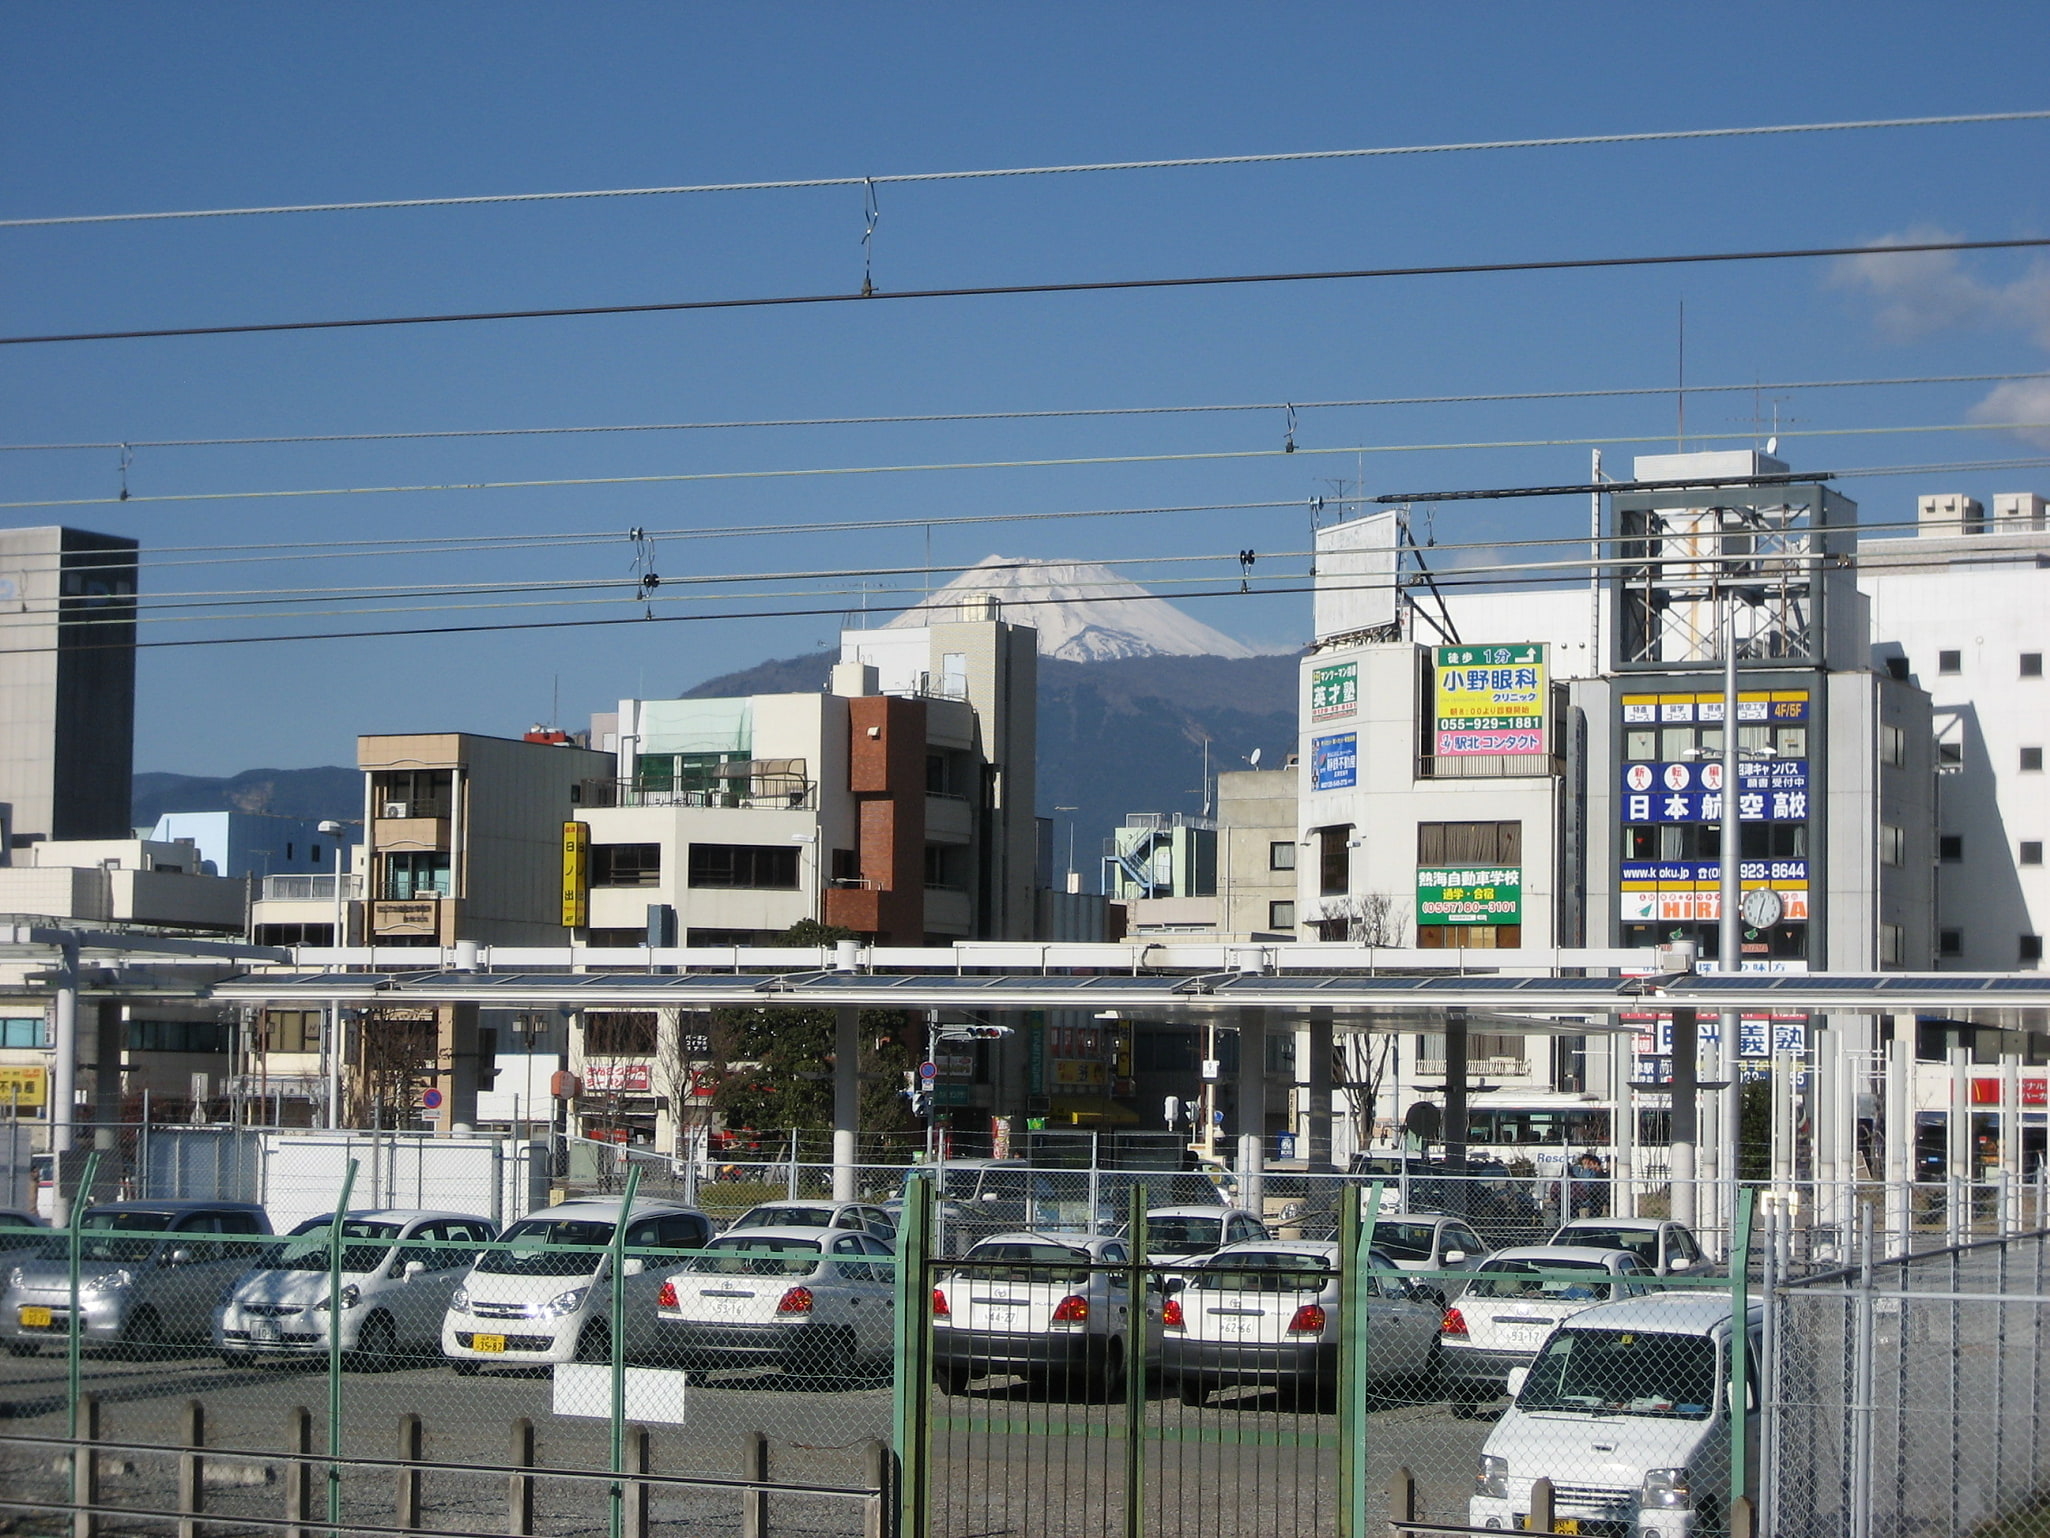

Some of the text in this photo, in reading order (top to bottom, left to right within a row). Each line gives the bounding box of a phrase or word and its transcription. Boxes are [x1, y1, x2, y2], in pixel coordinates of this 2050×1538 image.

[1447, 649, 1511, 664] 徒歩 1分
[1443, 668, 1538, 692] 小野眼科
[1313, 680, 1355, 708] 英才塾
[1492, 693, 1537, 703] クリニック
[1629, 713, 1650, 721] コース
[1741, 711, 1762, 719] コース
[1440, 717, 1539, 730] 055-929-1881
[1454, 735, 1538, 750] 駅北コンタクト
[1418, 870, 1519, 887] 熱海自動車学校
[1422, 901, 1516, 913] (0557)80-3101
[480, 1342, 502, 1351] 35-82
